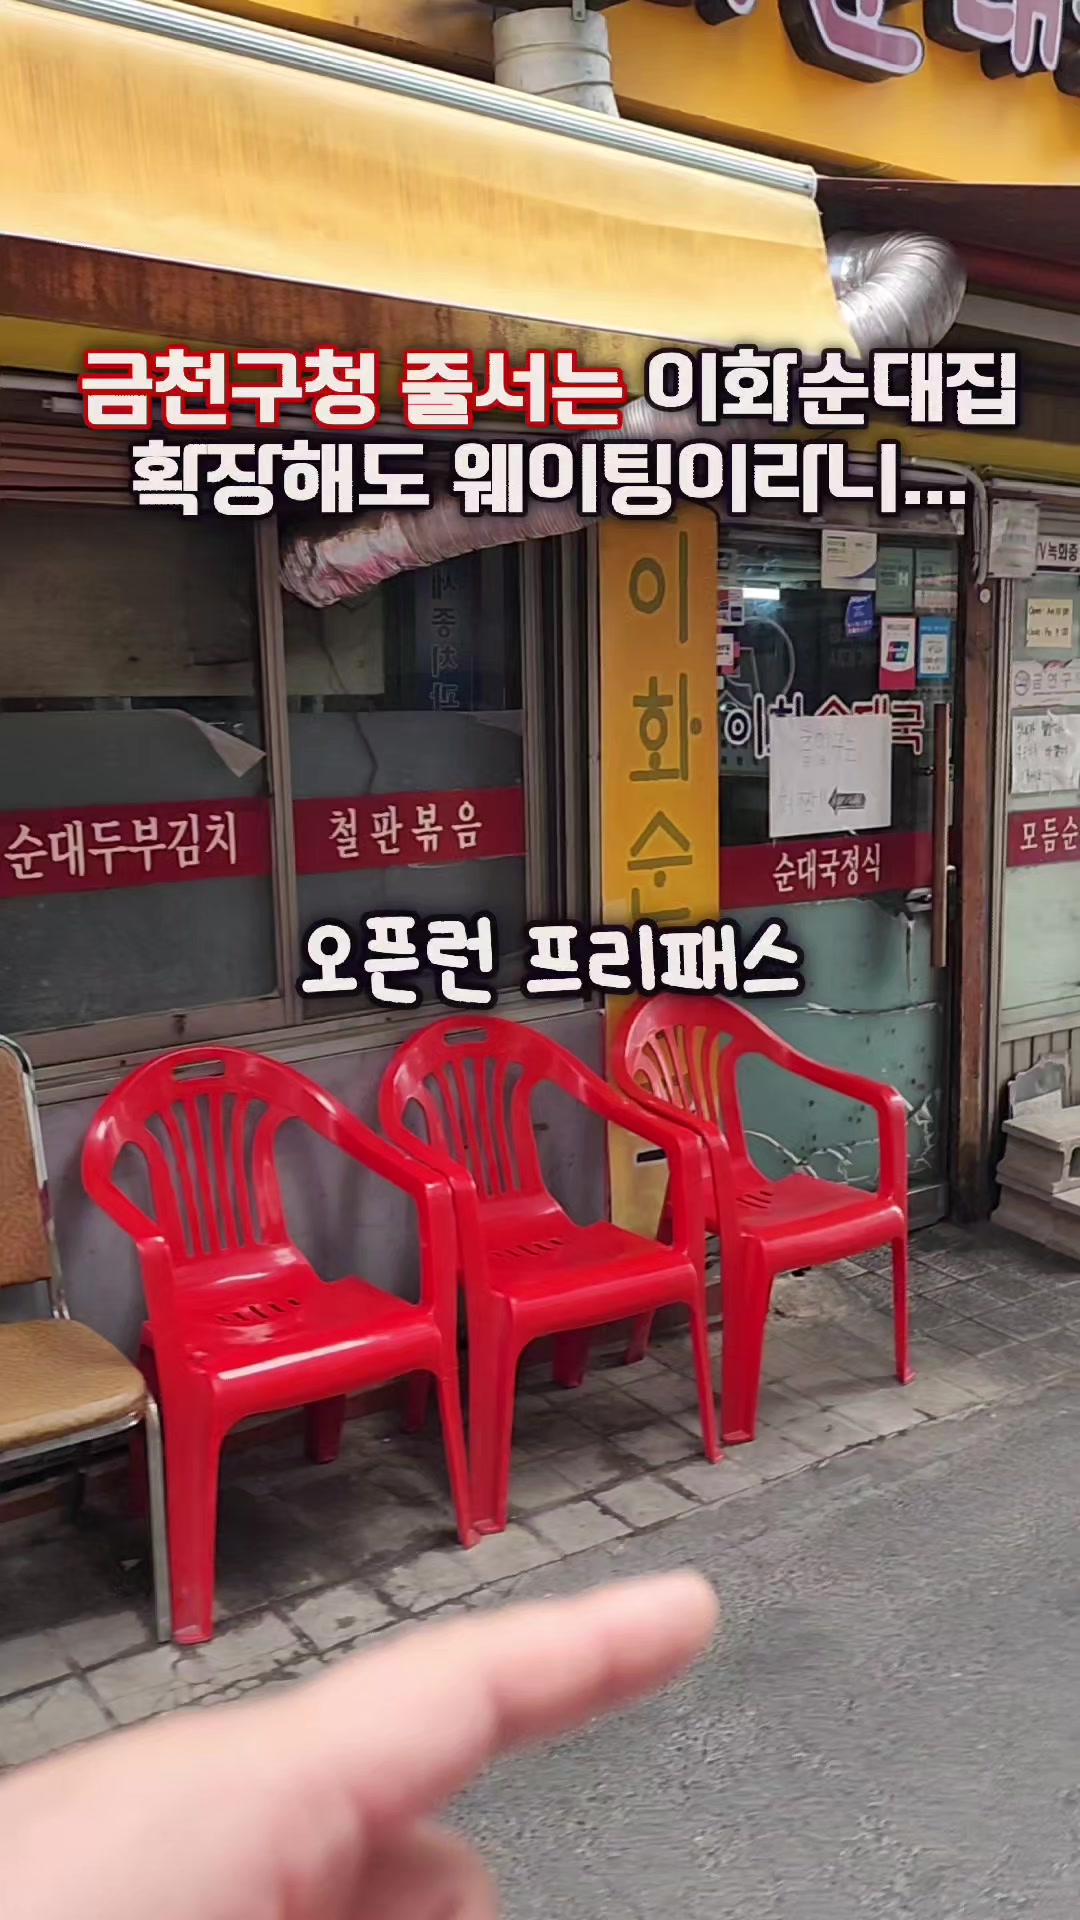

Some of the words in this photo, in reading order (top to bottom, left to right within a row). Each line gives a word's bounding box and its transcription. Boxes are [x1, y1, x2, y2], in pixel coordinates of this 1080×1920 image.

[1032, 672, 1080, 690] 금연구
[3, 810, 238, 879] 순대두부김치
[772, 843, 881, 893] 순대국정식
